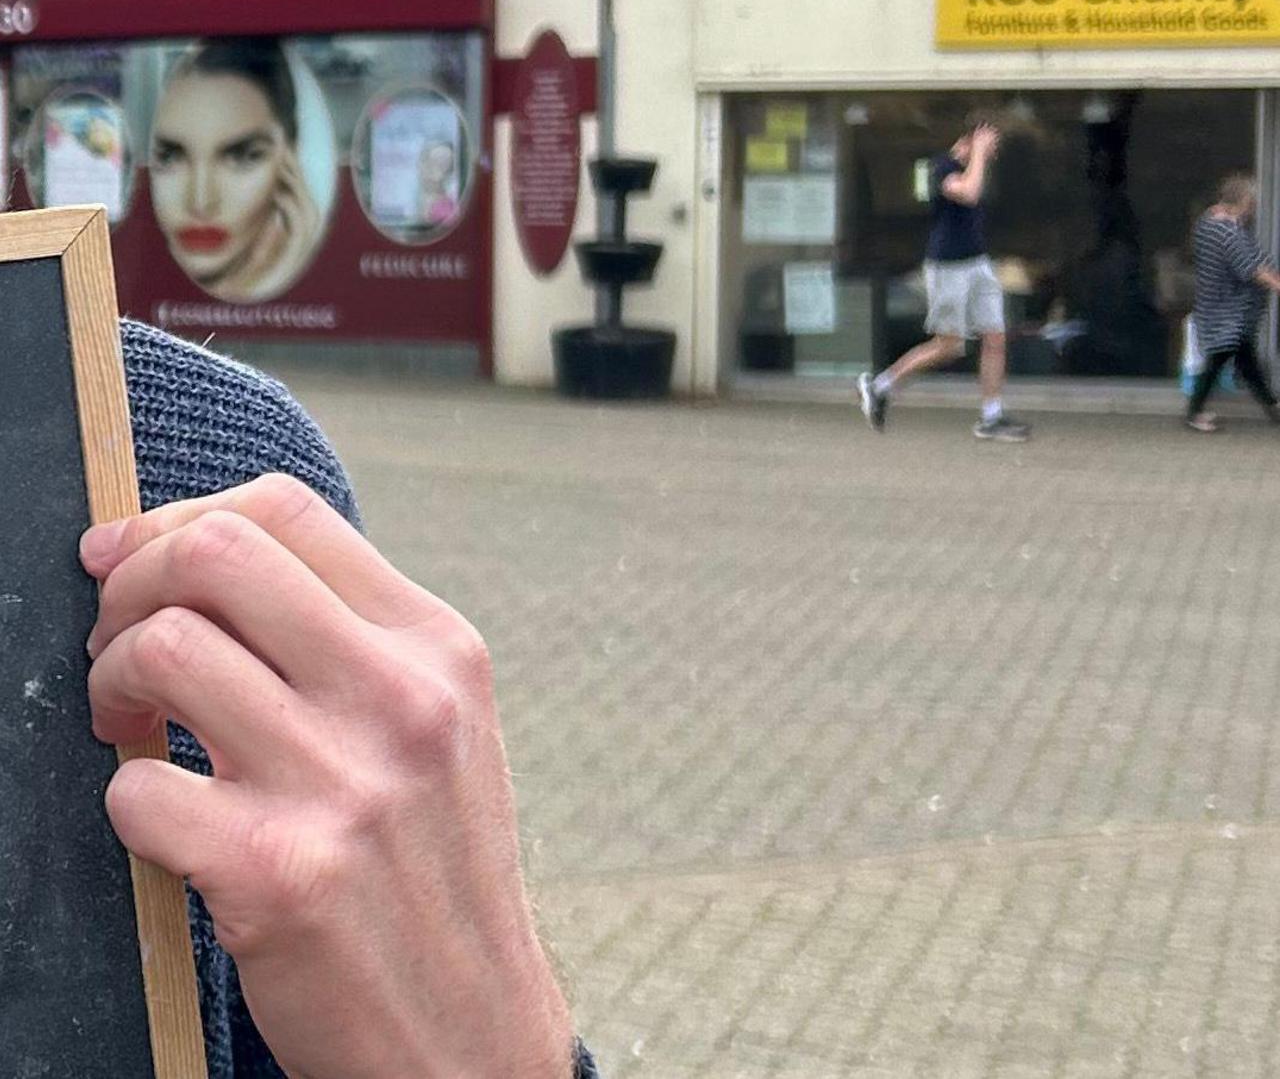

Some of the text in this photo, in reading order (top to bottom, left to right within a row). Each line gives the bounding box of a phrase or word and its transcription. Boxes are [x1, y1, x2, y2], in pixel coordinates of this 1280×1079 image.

[965, 5, 1270, 36] Furniture & Household Goods
